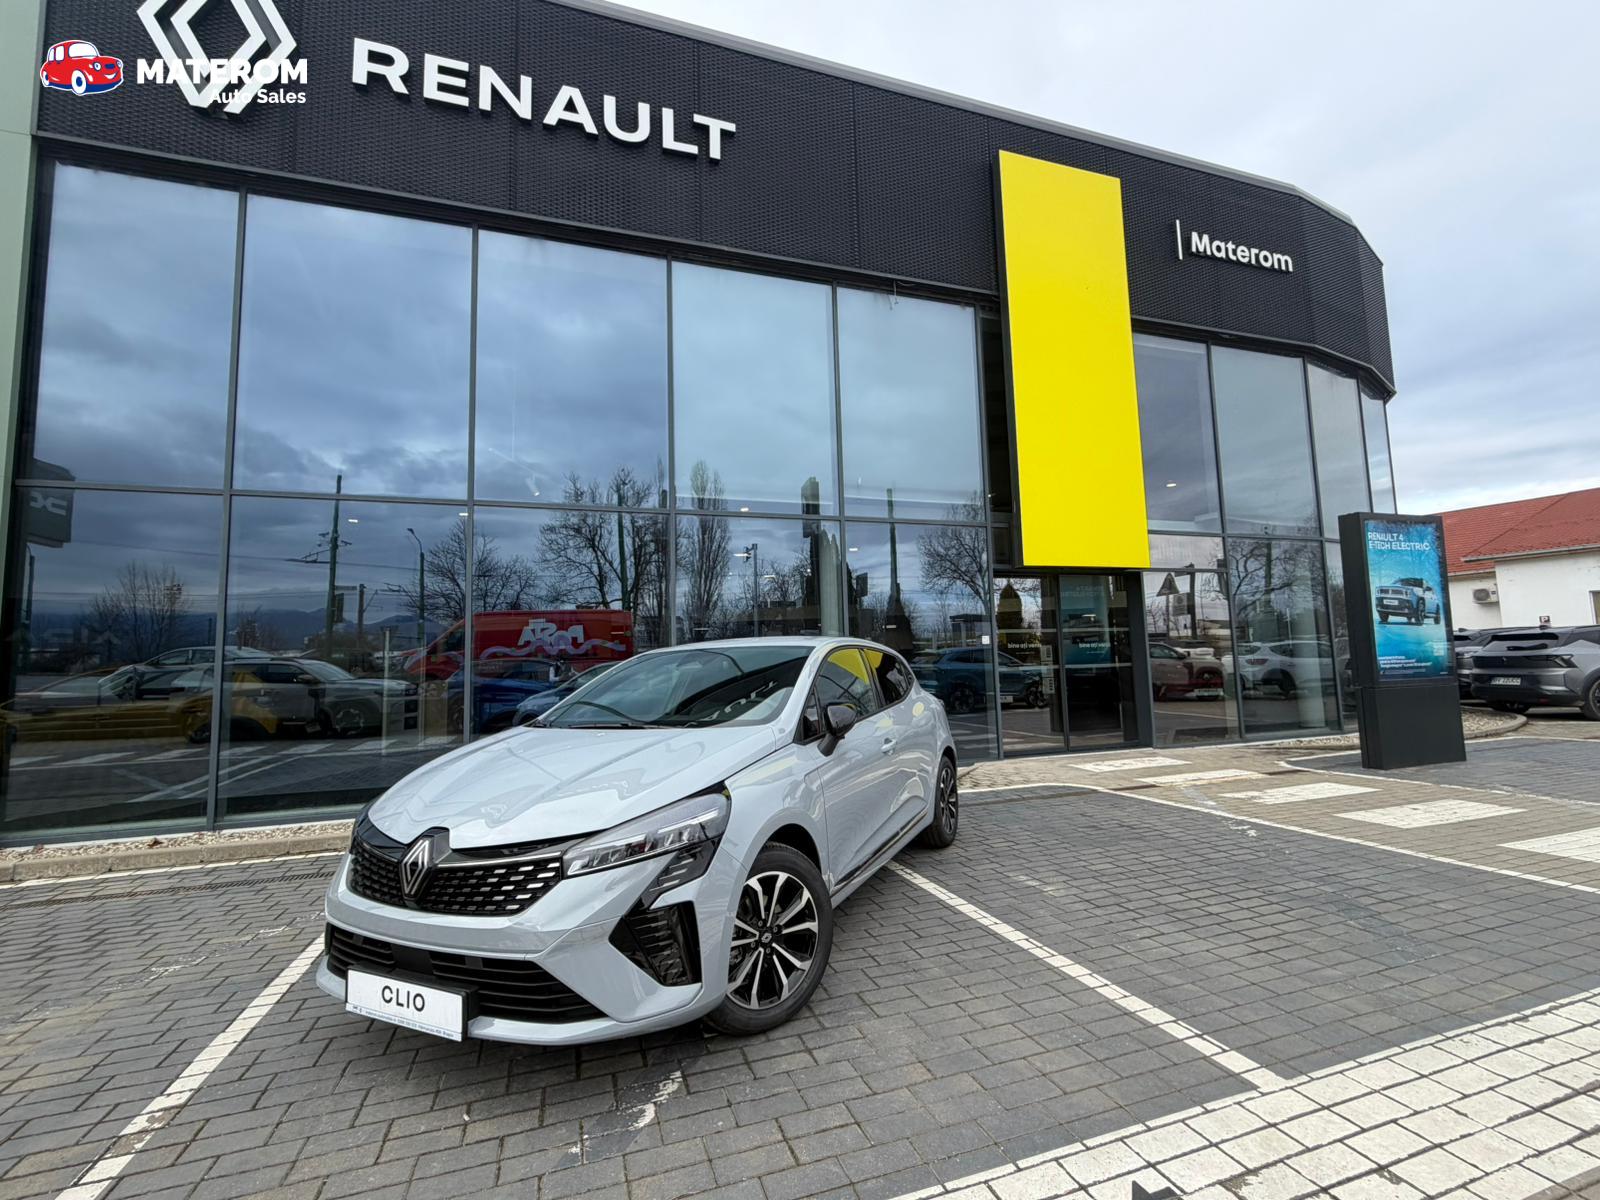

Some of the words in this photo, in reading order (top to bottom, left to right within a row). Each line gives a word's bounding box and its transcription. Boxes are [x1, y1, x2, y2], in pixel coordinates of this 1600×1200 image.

[352, 37, 736, 160] RENAULT
[1191, 231, 1293, 272] Materom
[1368, 531, 1397, 541] RENAULT
[1392, 541, 1430, 551] ELECTRIC
[381, 985, 425, 1012] CLIO
